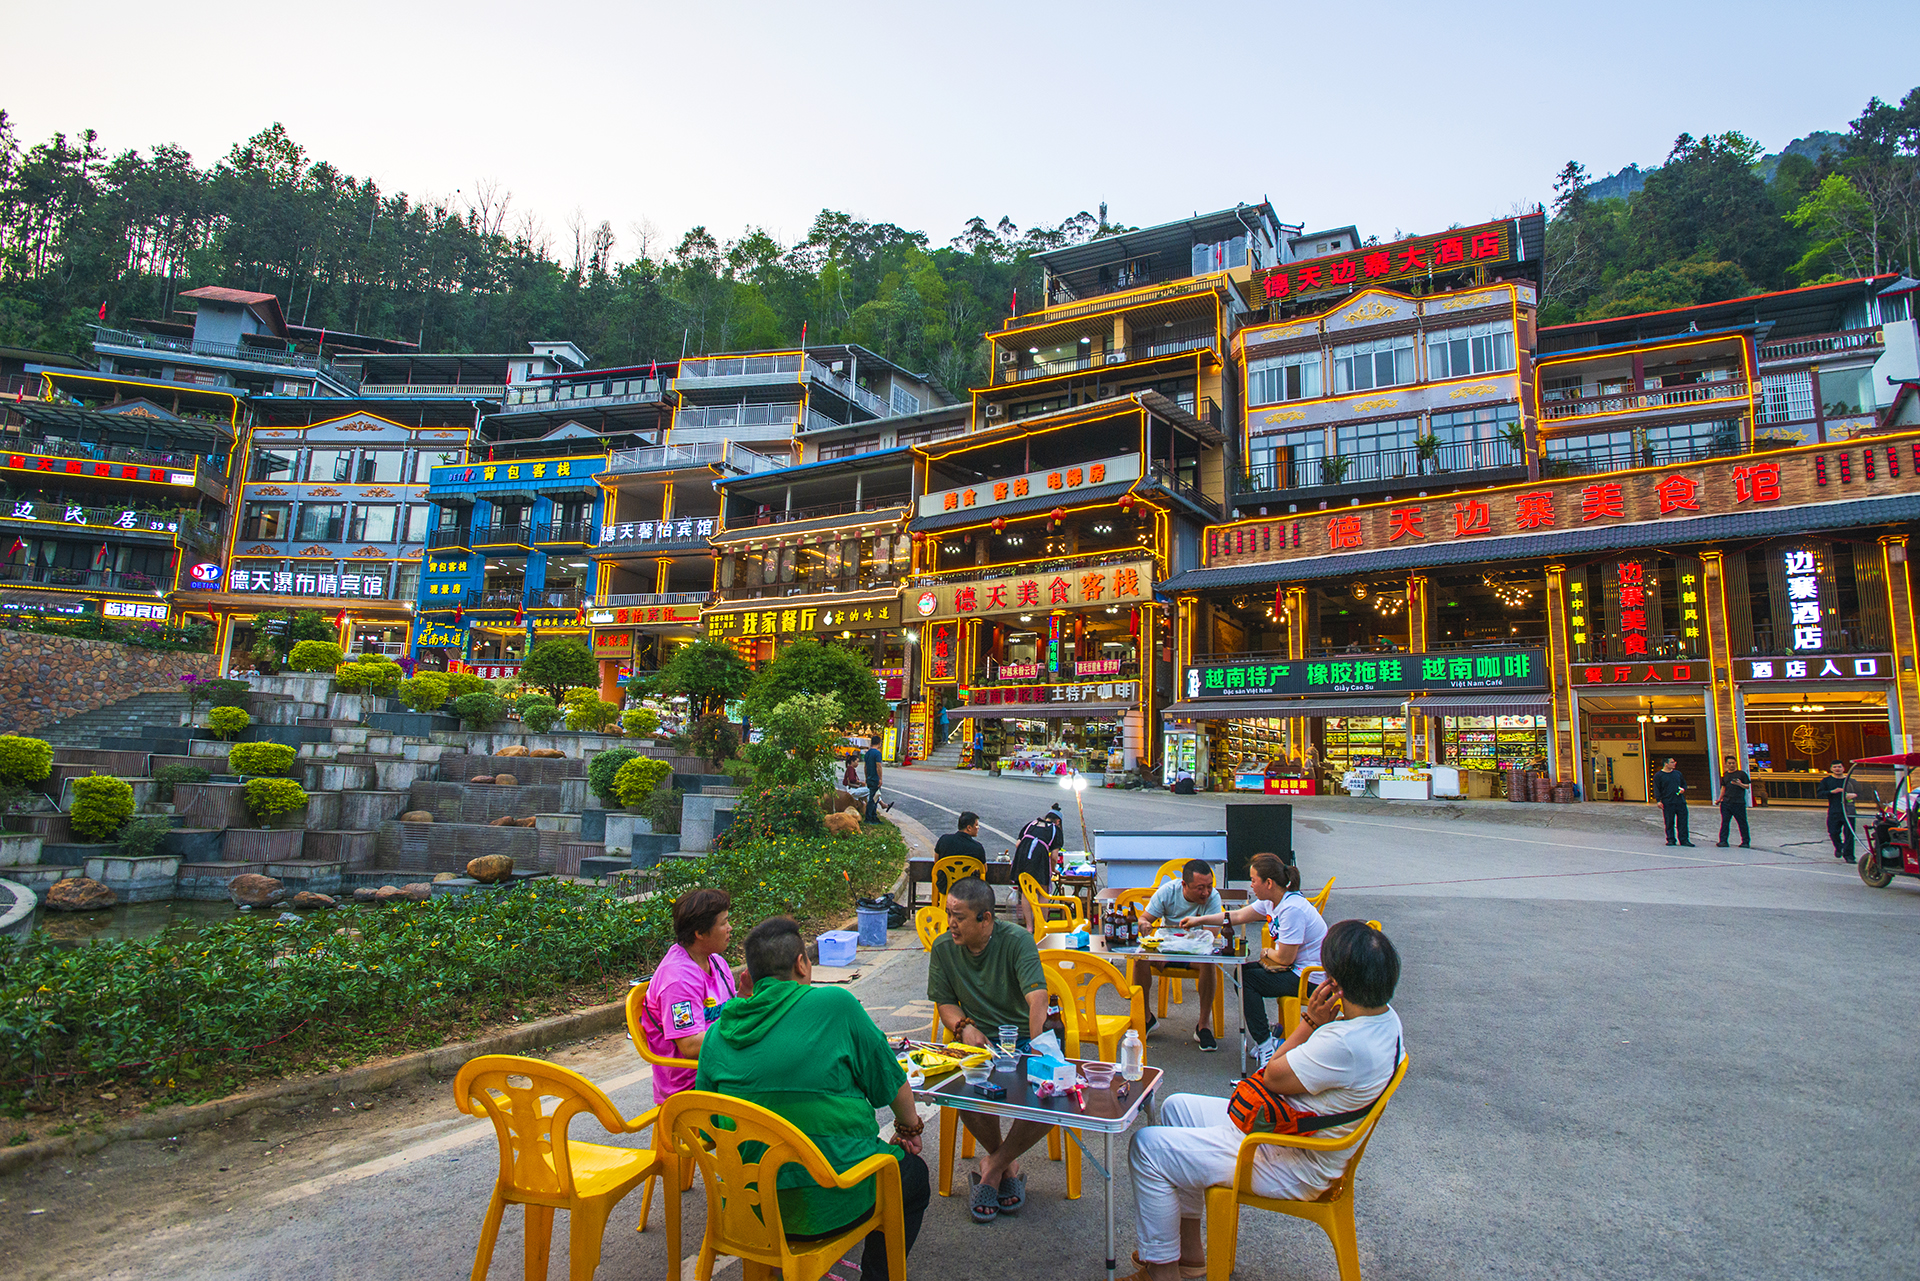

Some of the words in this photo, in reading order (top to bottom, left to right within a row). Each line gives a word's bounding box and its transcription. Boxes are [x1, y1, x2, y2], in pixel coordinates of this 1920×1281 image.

[1263, 232, 1500, 298] 德天边寨大酒店
[483, 462, 571, 481] 背包客栈
[944, 488, 976, 511] 美食
[993, 478, 1029, 501] 客栈
[1047, 463, 1106, 490] 电梯房
[12, 501, 138, 529] 边民居
[1328, 462, 1782, 550] 德天边寨美食馆
[601, 519, 714, 542] 德天馨怡宾馆
[429, 561, 467, 573] 背包客栈
[191, 581, 220, 589] DETIAN
[230, 570, 383, 596] 德天瀑布情宾馆
[954, 568, 1140, 613] 德天美食客栈
[1570, 582, 1586, 645] 早中晚餐
[1618, 562, 1648, 655] 边寨美食
[1682, 574, 1699, 639] 中越风味
[1785, 550, 1823, 650] 边寨酒店
[616, 607, 676, 623] 馨怡宾馆
[742, 608, 817, 635] 我家餐厅
[834, 606, 890, 625] 家的味道
[417, 633, 462, 646] 越南味道
[934, 626, 949, 678] 本地菜
[1205, 665, 1290, 689] 越南特产
[1307, 659, 1402, 686] 橡胶拖鞋
[1422, 654, 1531, 681] 越南咖啡
[1584, 665, 1692, 683] 餐厅入口
[1752, 659, 1877, 678] 酒店入口
[1052, 682, 1131, 702] 土特产咖啡
